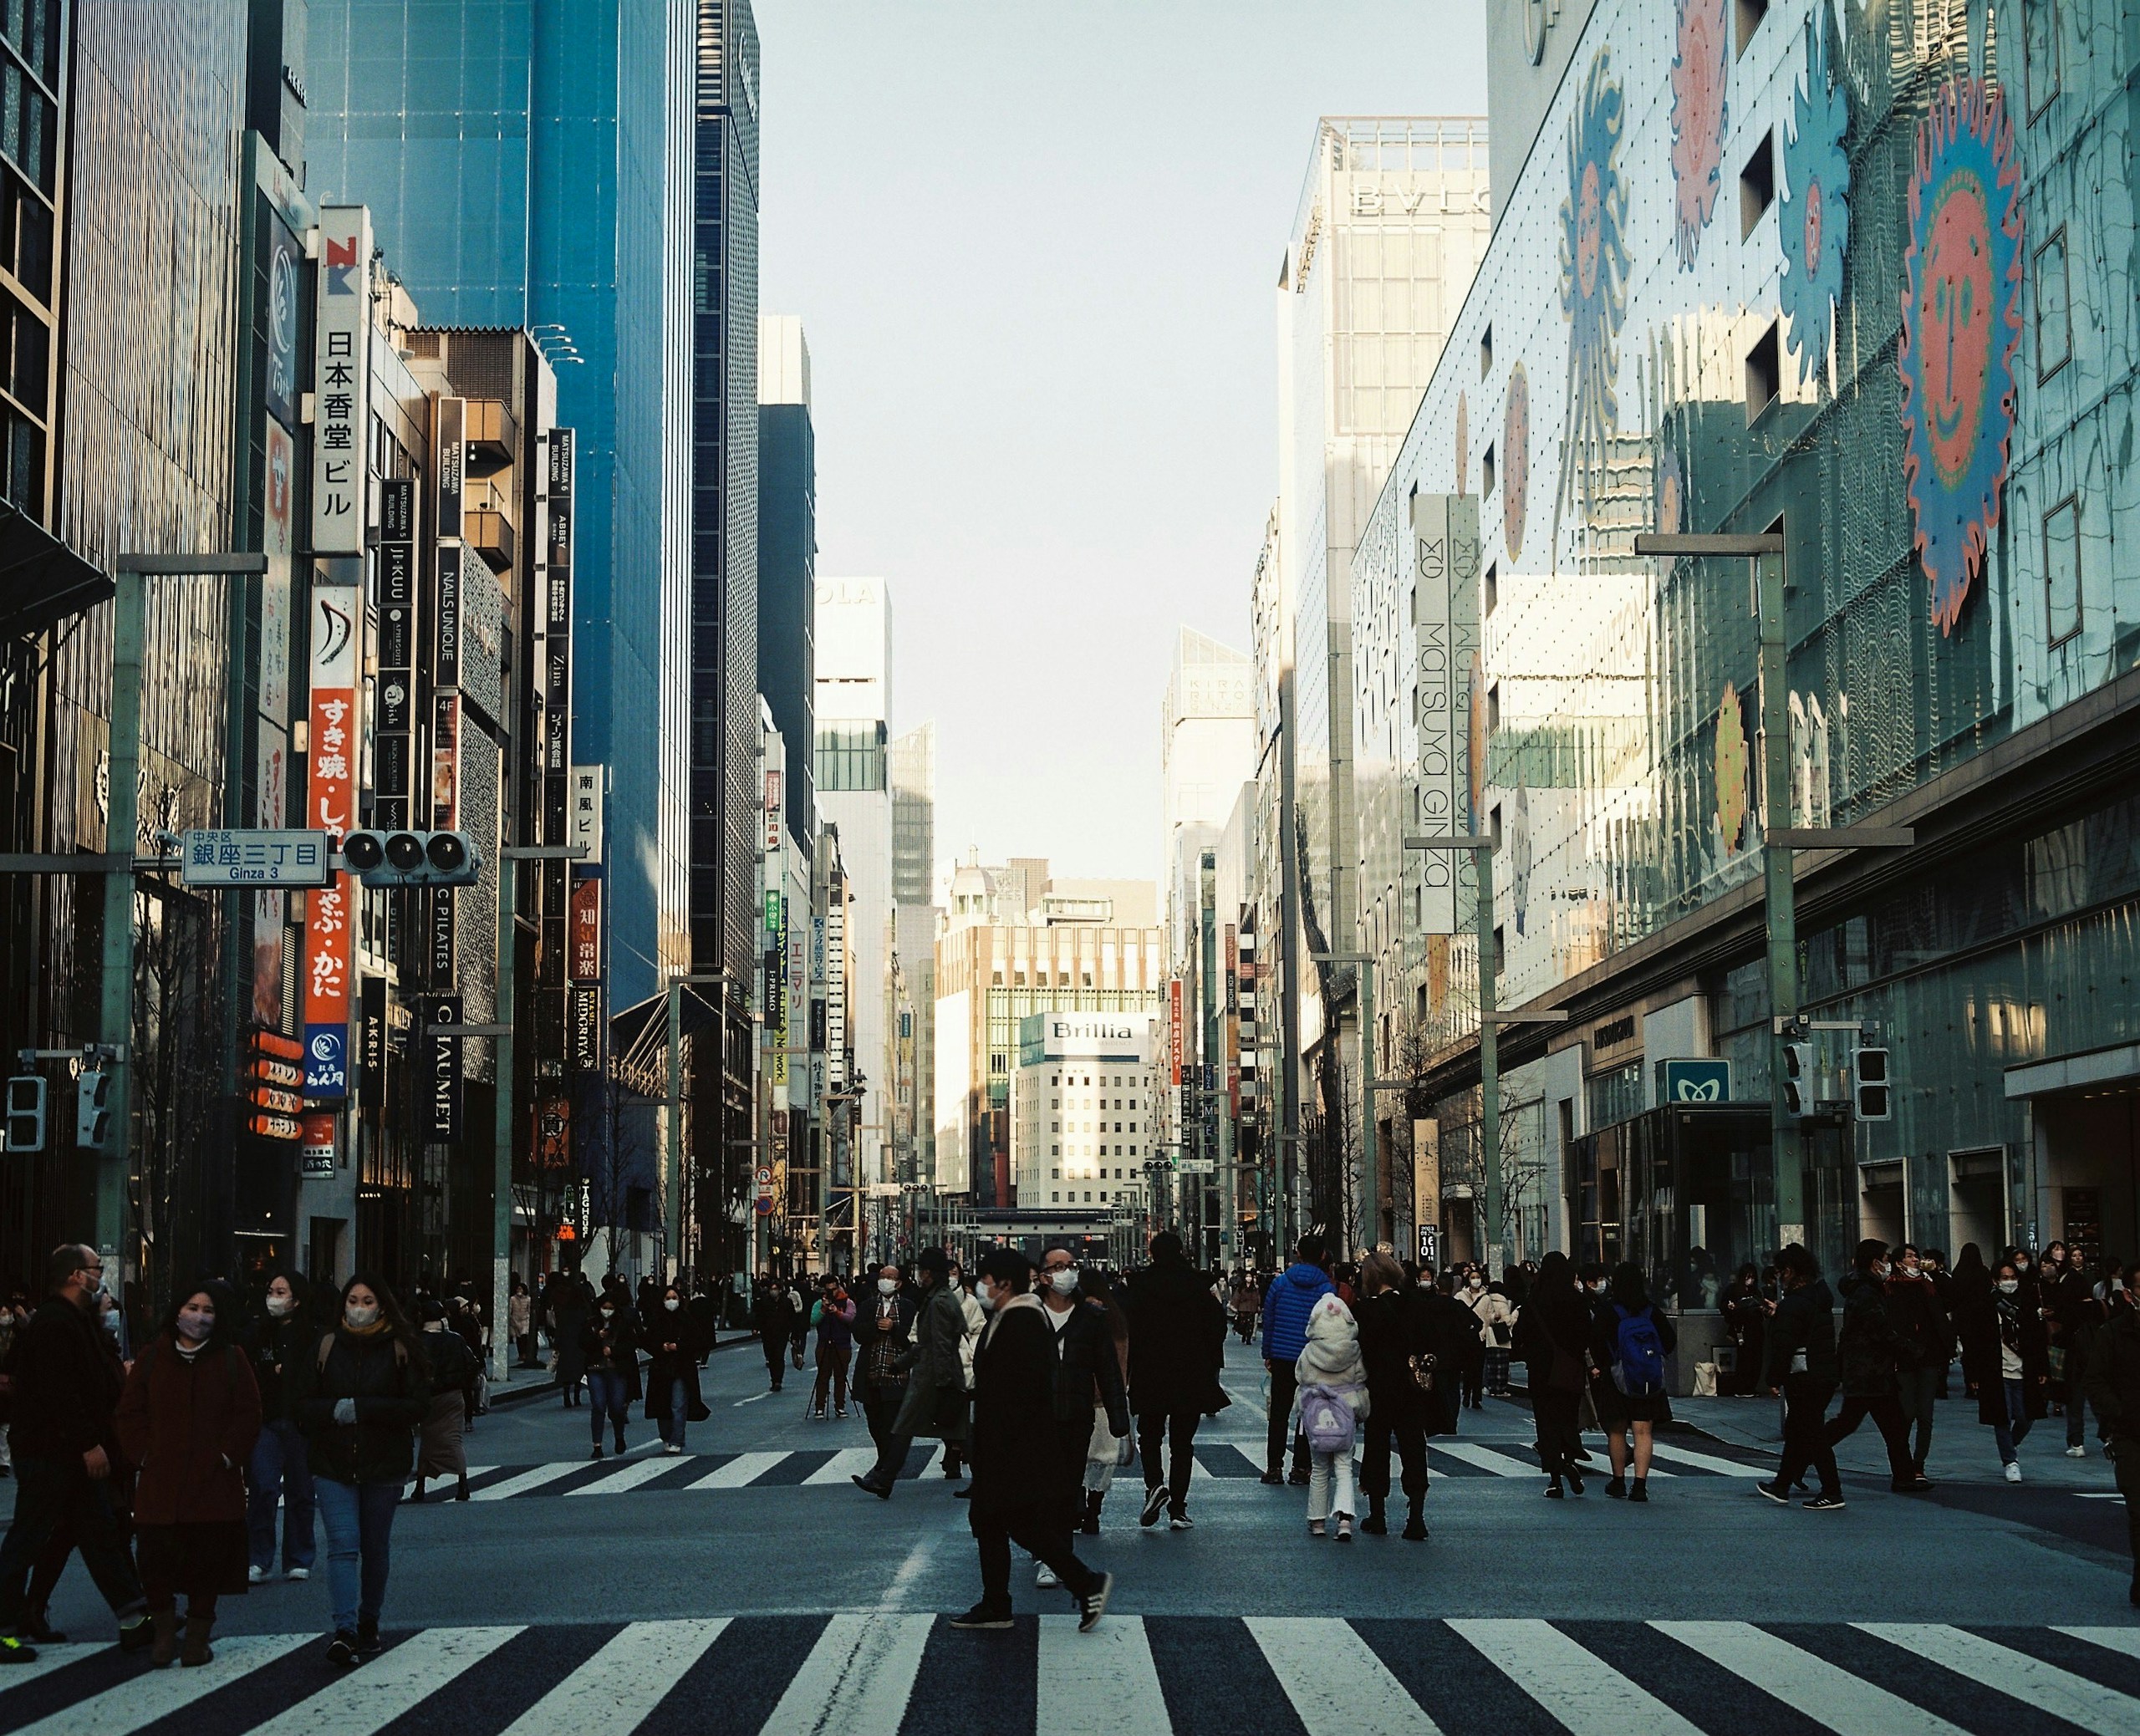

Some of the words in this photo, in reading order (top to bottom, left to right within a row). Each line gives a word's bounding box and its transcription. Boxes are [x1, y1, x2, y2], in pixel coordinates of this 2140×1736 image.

[324, 332, 353, 516] 日本香堂ビル
[442, 448, 451, 489] BUILDING
[451, 441, 460, 495] MATSUZAWA
[558, 515, 567, 549] ABBEY
[442, 572, 455, 608] NAILS
[442, 611, 454, 661] UNIQUE
[553, 654, 564, 687] Zina
[439, 700, 454, 711] 4F
[193, 831, 232, 843] 中央区
[192, 843, 316, 866] 銀座三丁目
[229, 867, 265, 879] Ginza
[270, 867, 278, 878] 3
[436, 907, 449, 969] PILATES
[791, 943, 802, 1009] エニマリ
[1052, 1022, 1134, 1038] Brillia
[307, 1071, 344, 1087] らん月
